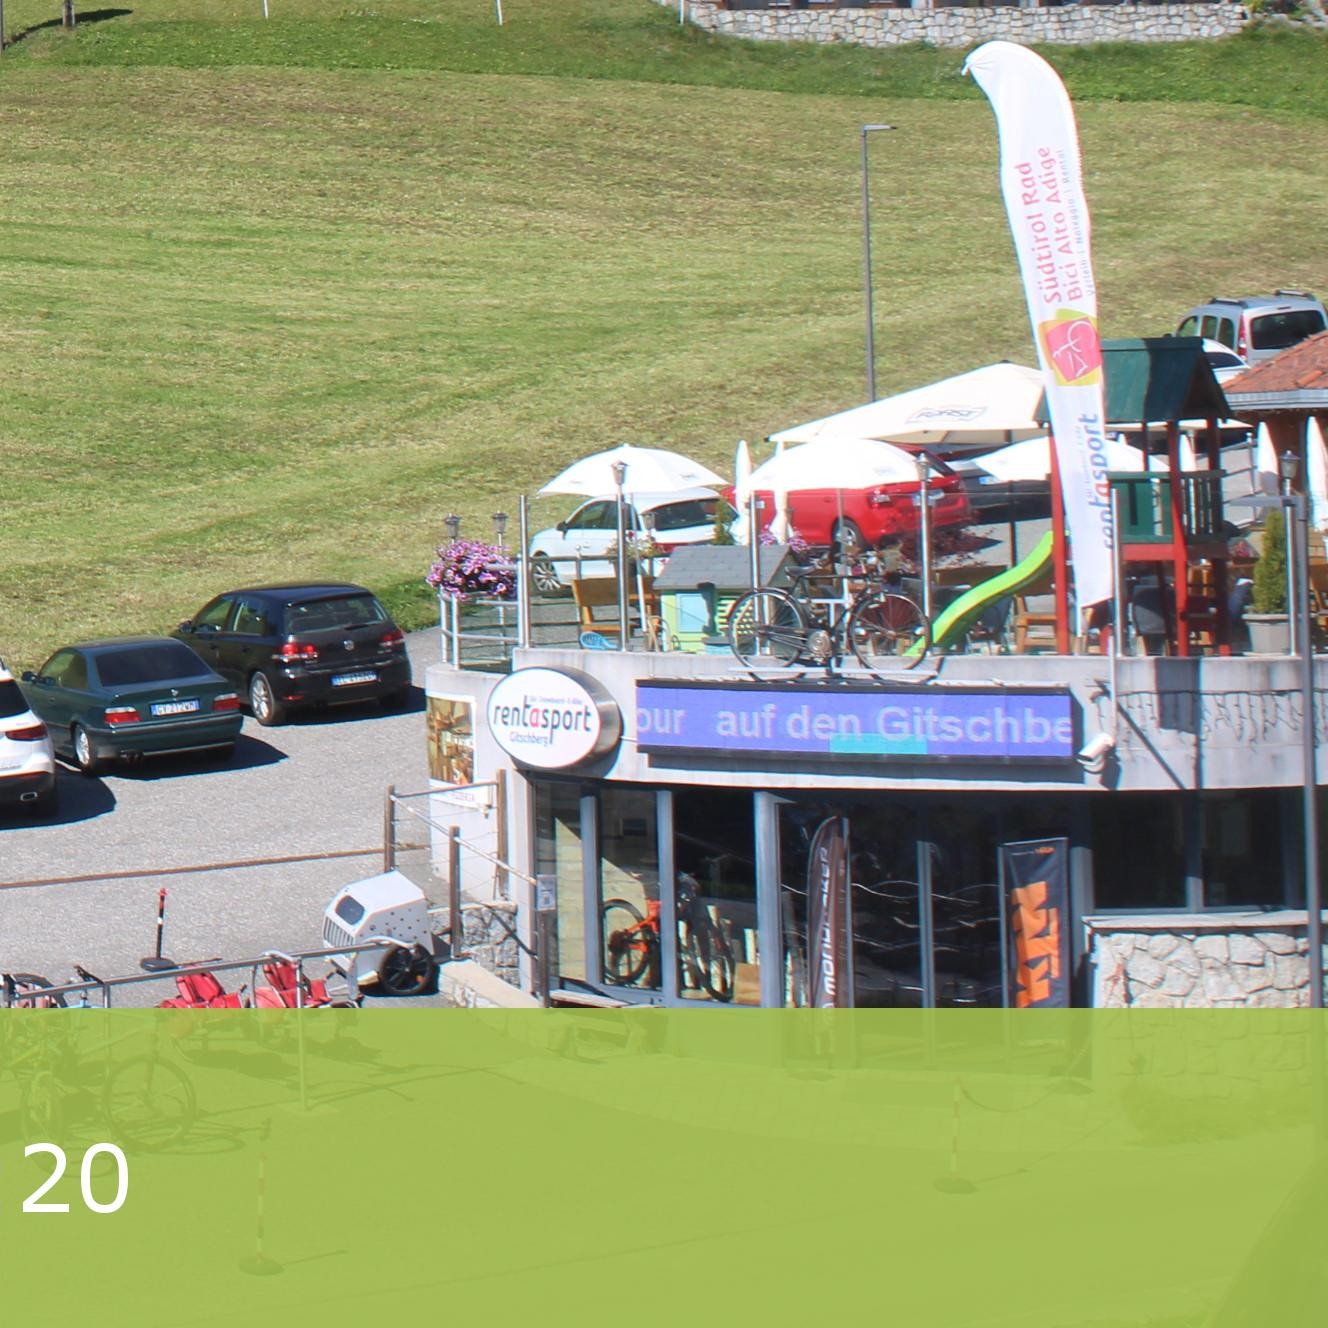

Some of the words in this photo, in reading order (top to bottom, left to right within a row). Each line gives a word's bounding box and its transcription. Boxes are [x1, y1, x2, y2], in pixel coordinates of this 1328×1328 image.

[1014, 162, 1040, 206] Rad
[1037, 147, 1061, 204] Adige
[1052, 212, 1074, 255] Alto
[1026, 213, 1062, 304] Südtirol
[1059, 263, 1083, 301] Bici
[494, 694, 592, 744] rentasport
[717, 703, 777, 738] auf
[787, 704, 862, 741] den
[877, 705, 1073, 743] Gitschbe
[1011, 881, 1059, 1008] KTM
